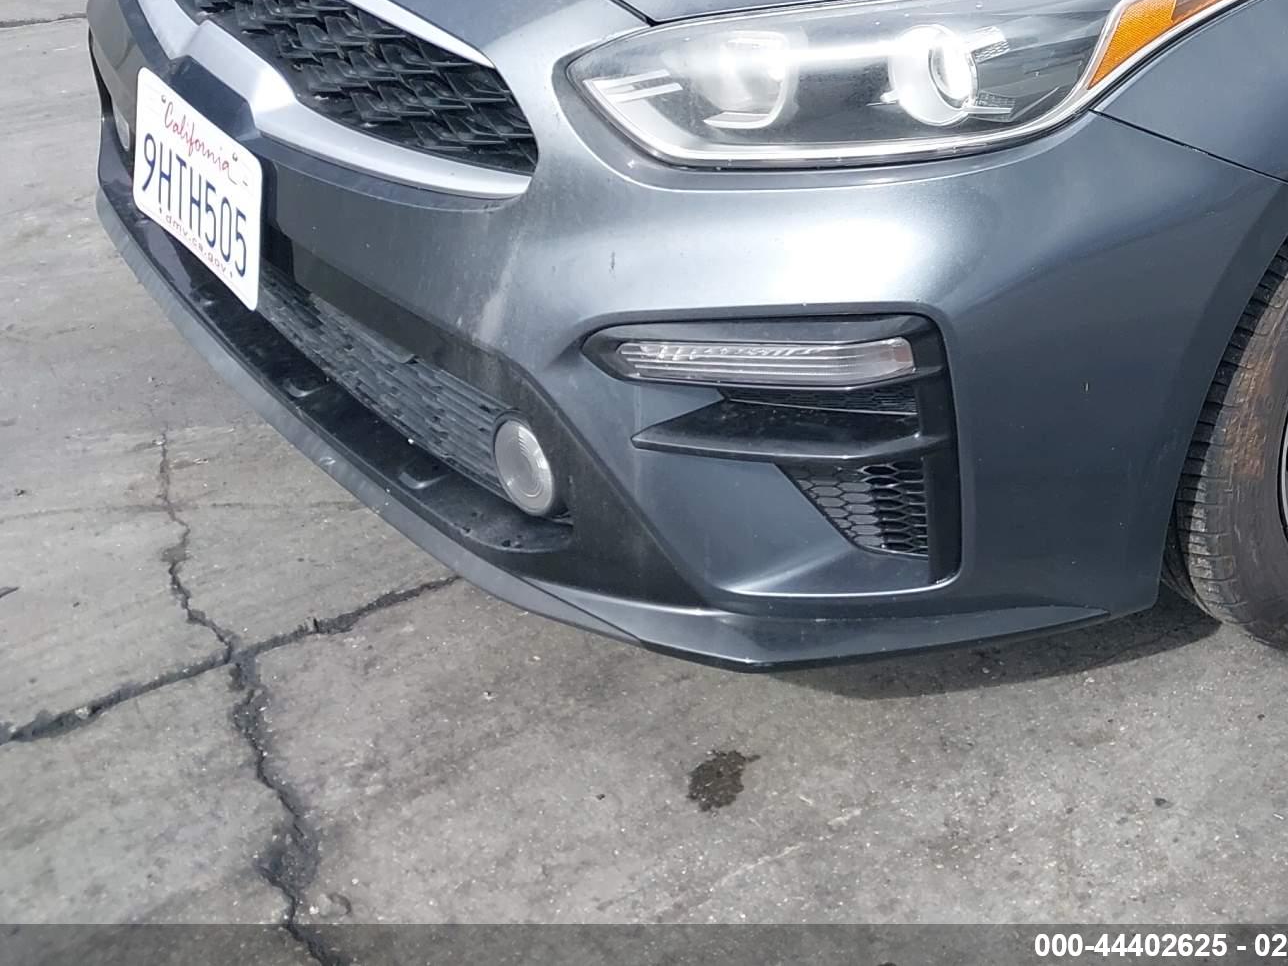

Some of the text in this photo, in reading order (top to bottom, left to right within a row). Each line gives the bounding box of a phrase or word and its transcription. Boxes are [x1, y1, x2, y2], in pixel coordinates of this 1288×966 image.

[163, 100, 238, 185] California
[142, 132, 247, 278] 9HTH505
[164, 213, 228, 275] dmv.ca.gov
